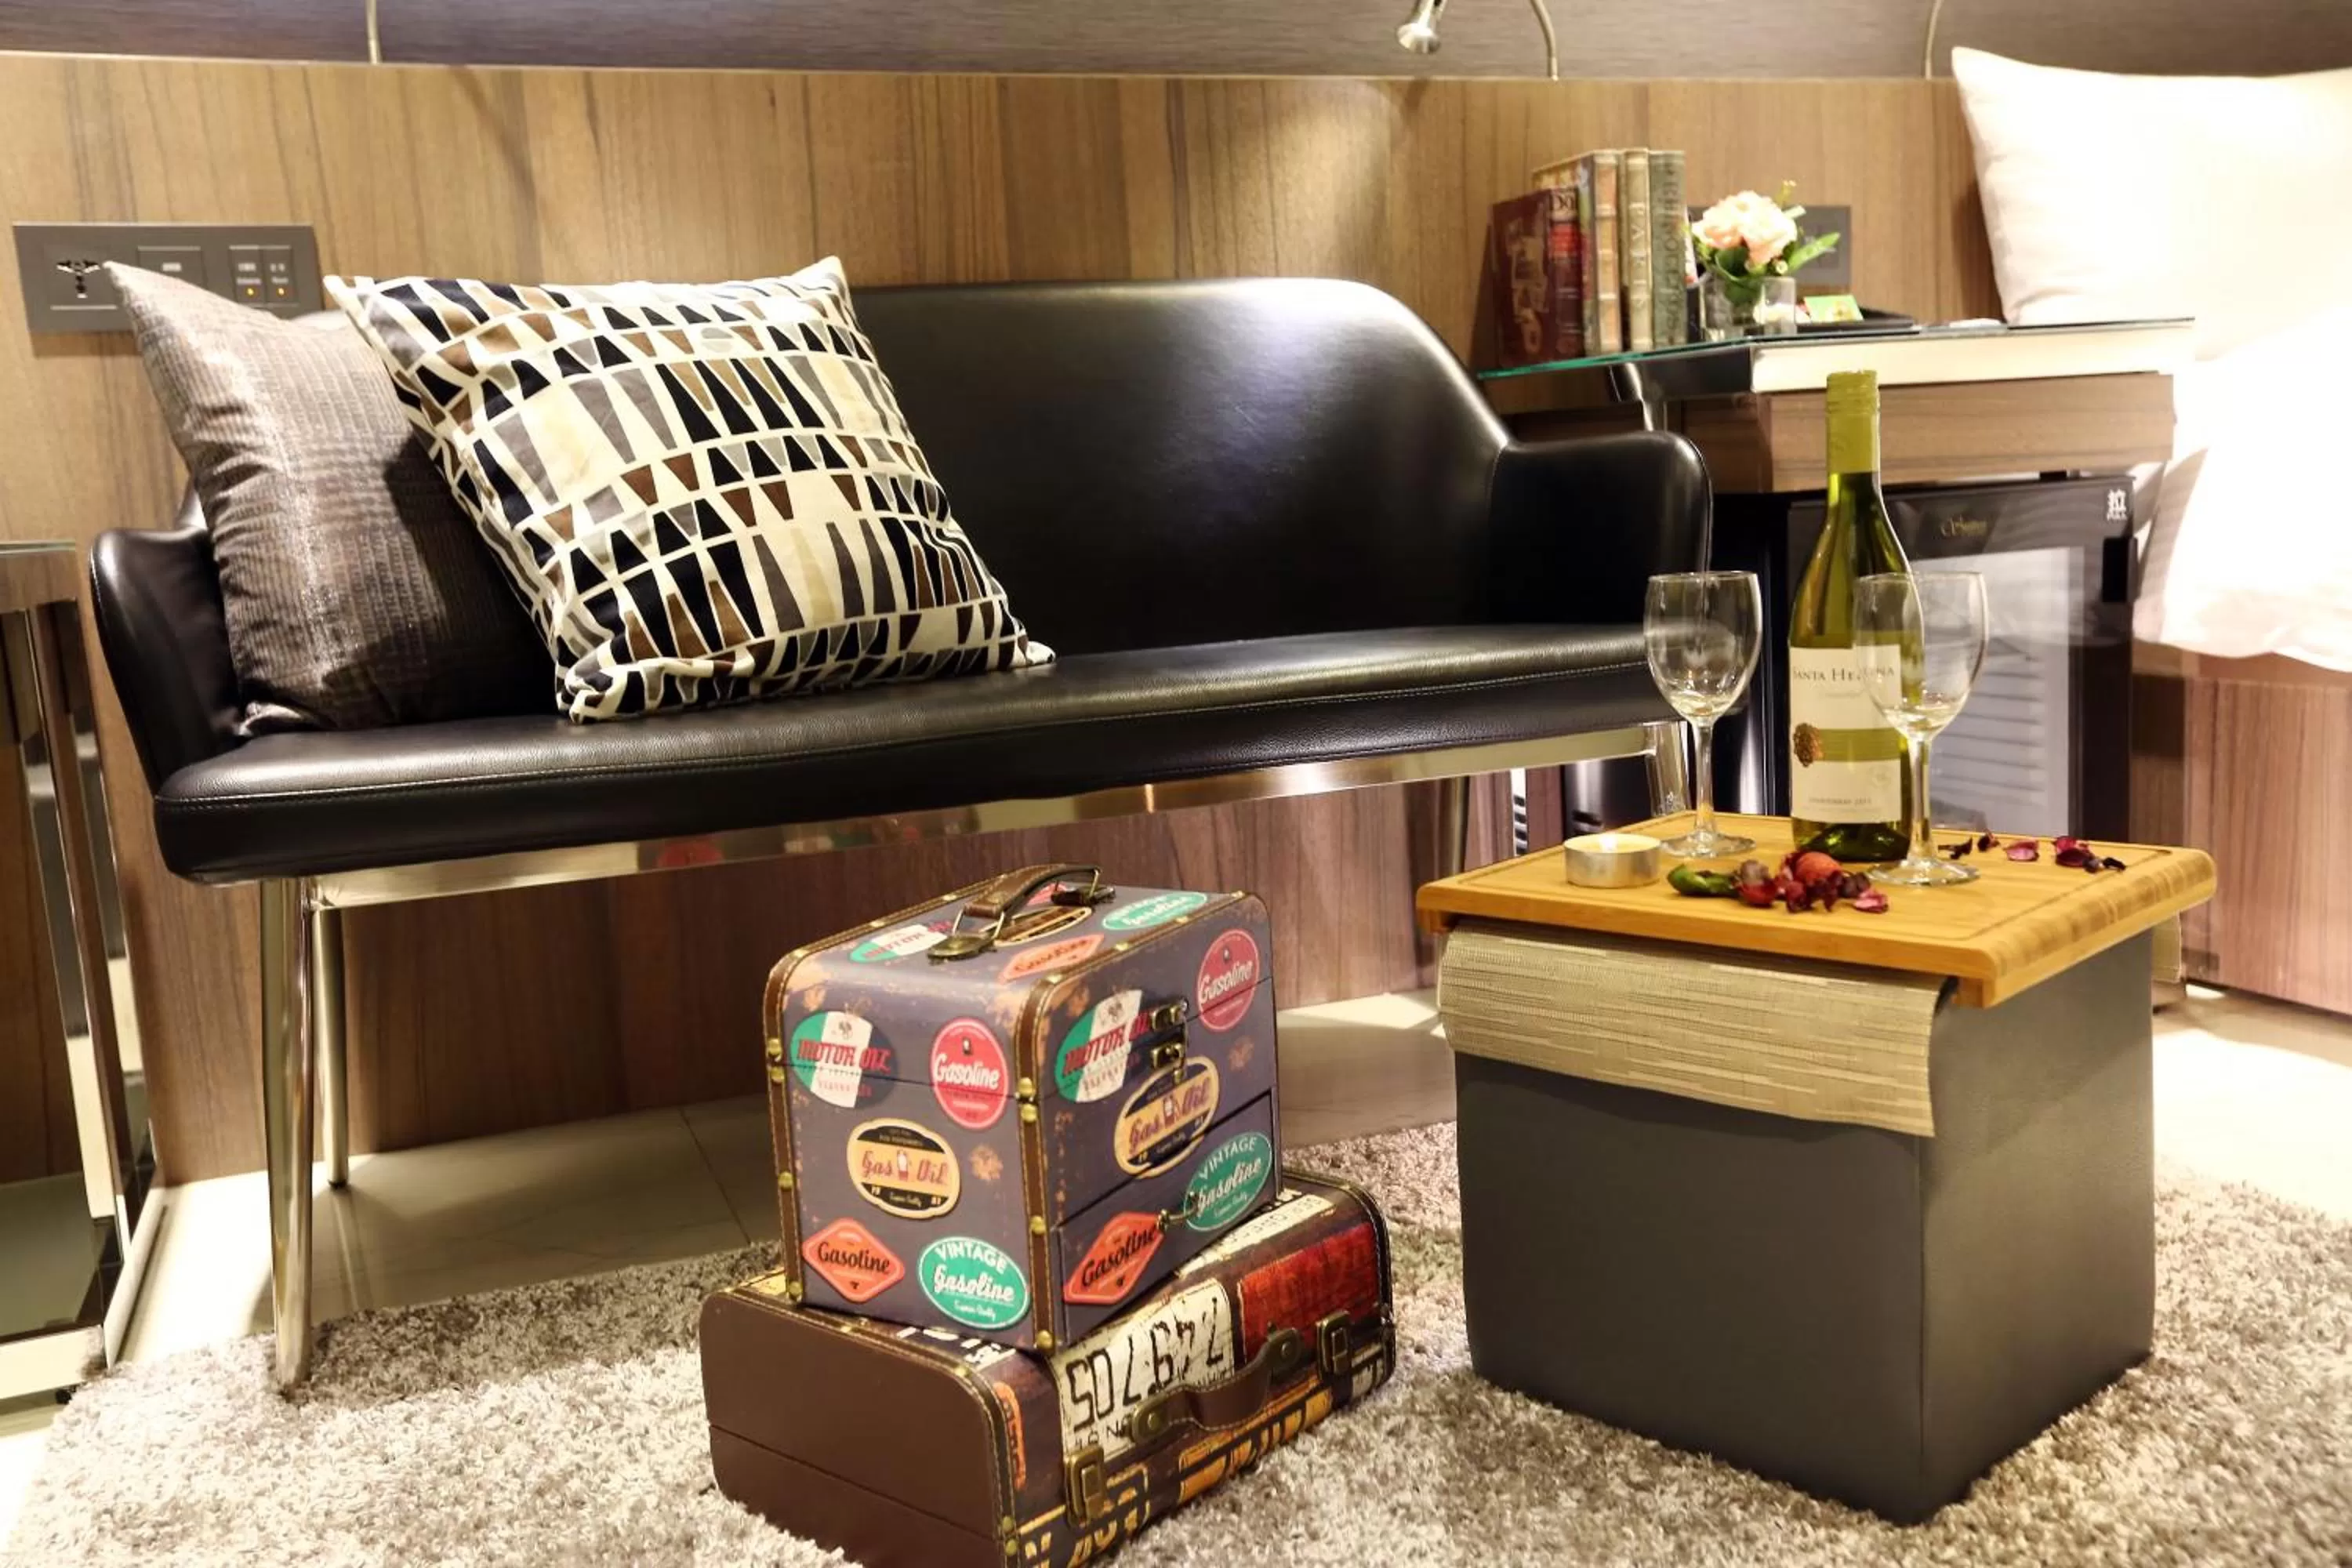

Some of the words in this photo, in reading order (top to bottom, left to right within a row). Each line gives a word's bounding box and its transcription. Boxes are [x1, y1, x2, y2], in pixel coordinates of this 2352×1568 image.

[1200, 960, 1254, 1004] Gasoline
[797, 1039, 857, 1067] MOTOR
[934, 1052, 1000, 1091] Gasoline
[861, 1149, 894, 1179] Gas
[1198, 1136, 1258, 1180] VINTAGE
[817, 1240, 891, 1275] Gasoline
[934, 1240, 1008, 1275] VINTAGE
[1081, 1223, 1157, 1290] Gasoline
[933, 1263, 1015, 1303] Gasoline
